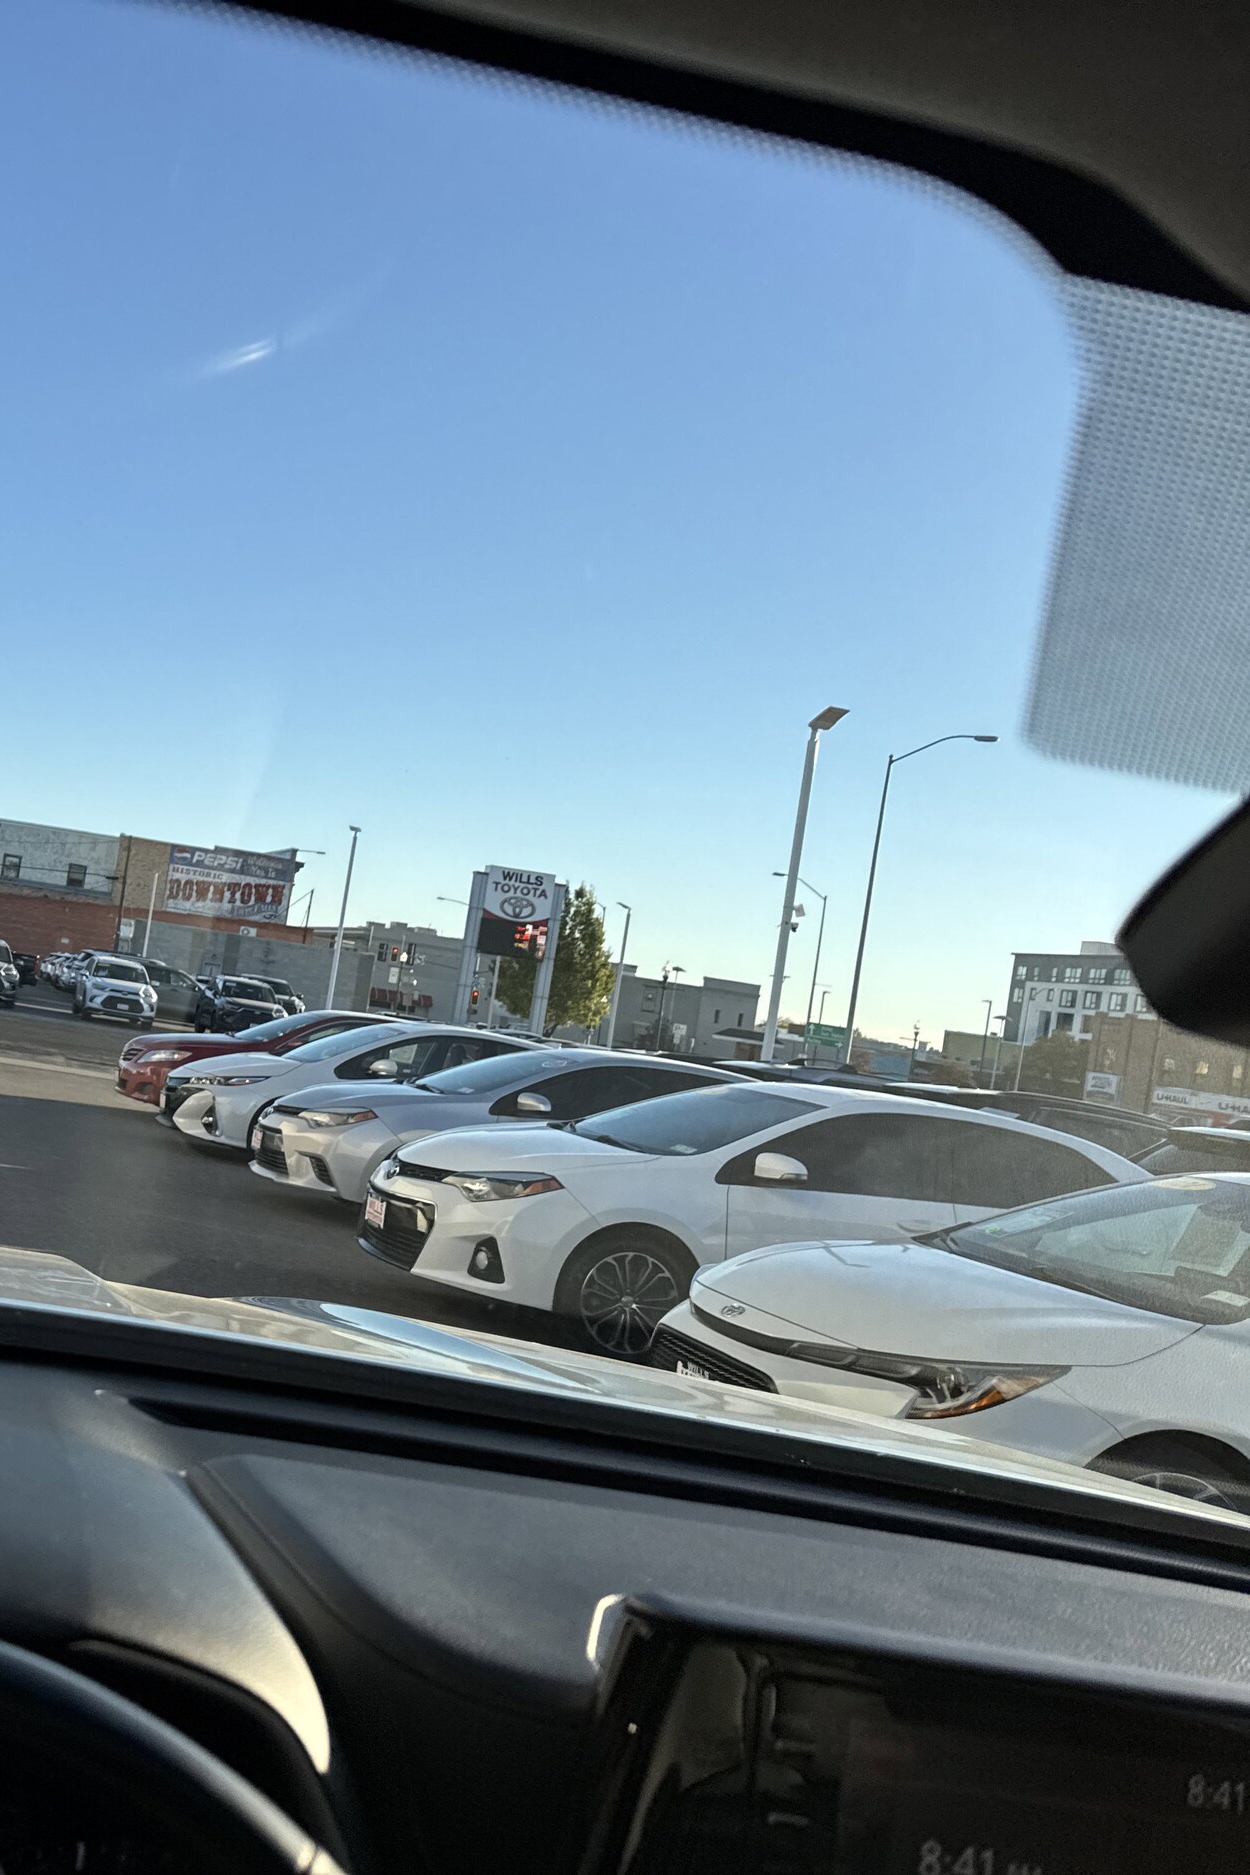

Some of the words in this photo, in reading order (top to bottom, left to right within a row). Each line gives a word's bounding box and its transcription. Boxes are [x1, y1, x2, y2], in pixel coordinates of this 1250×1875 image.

[192, 851, 243, 870] PEPSI
[171, 865, 225, 880] HISTORIC
[502, 870, 544, 887] WILLS
[167, 878, 286, 907] DOWNTOWN
[492, 881, 548, 899] TOYOTA
[1156, 1092, 1189, 1105] U-HAUL
[1187, 1773, 1248, 1816] 8:41
[917, 1838, 995, 1875] 8:41
